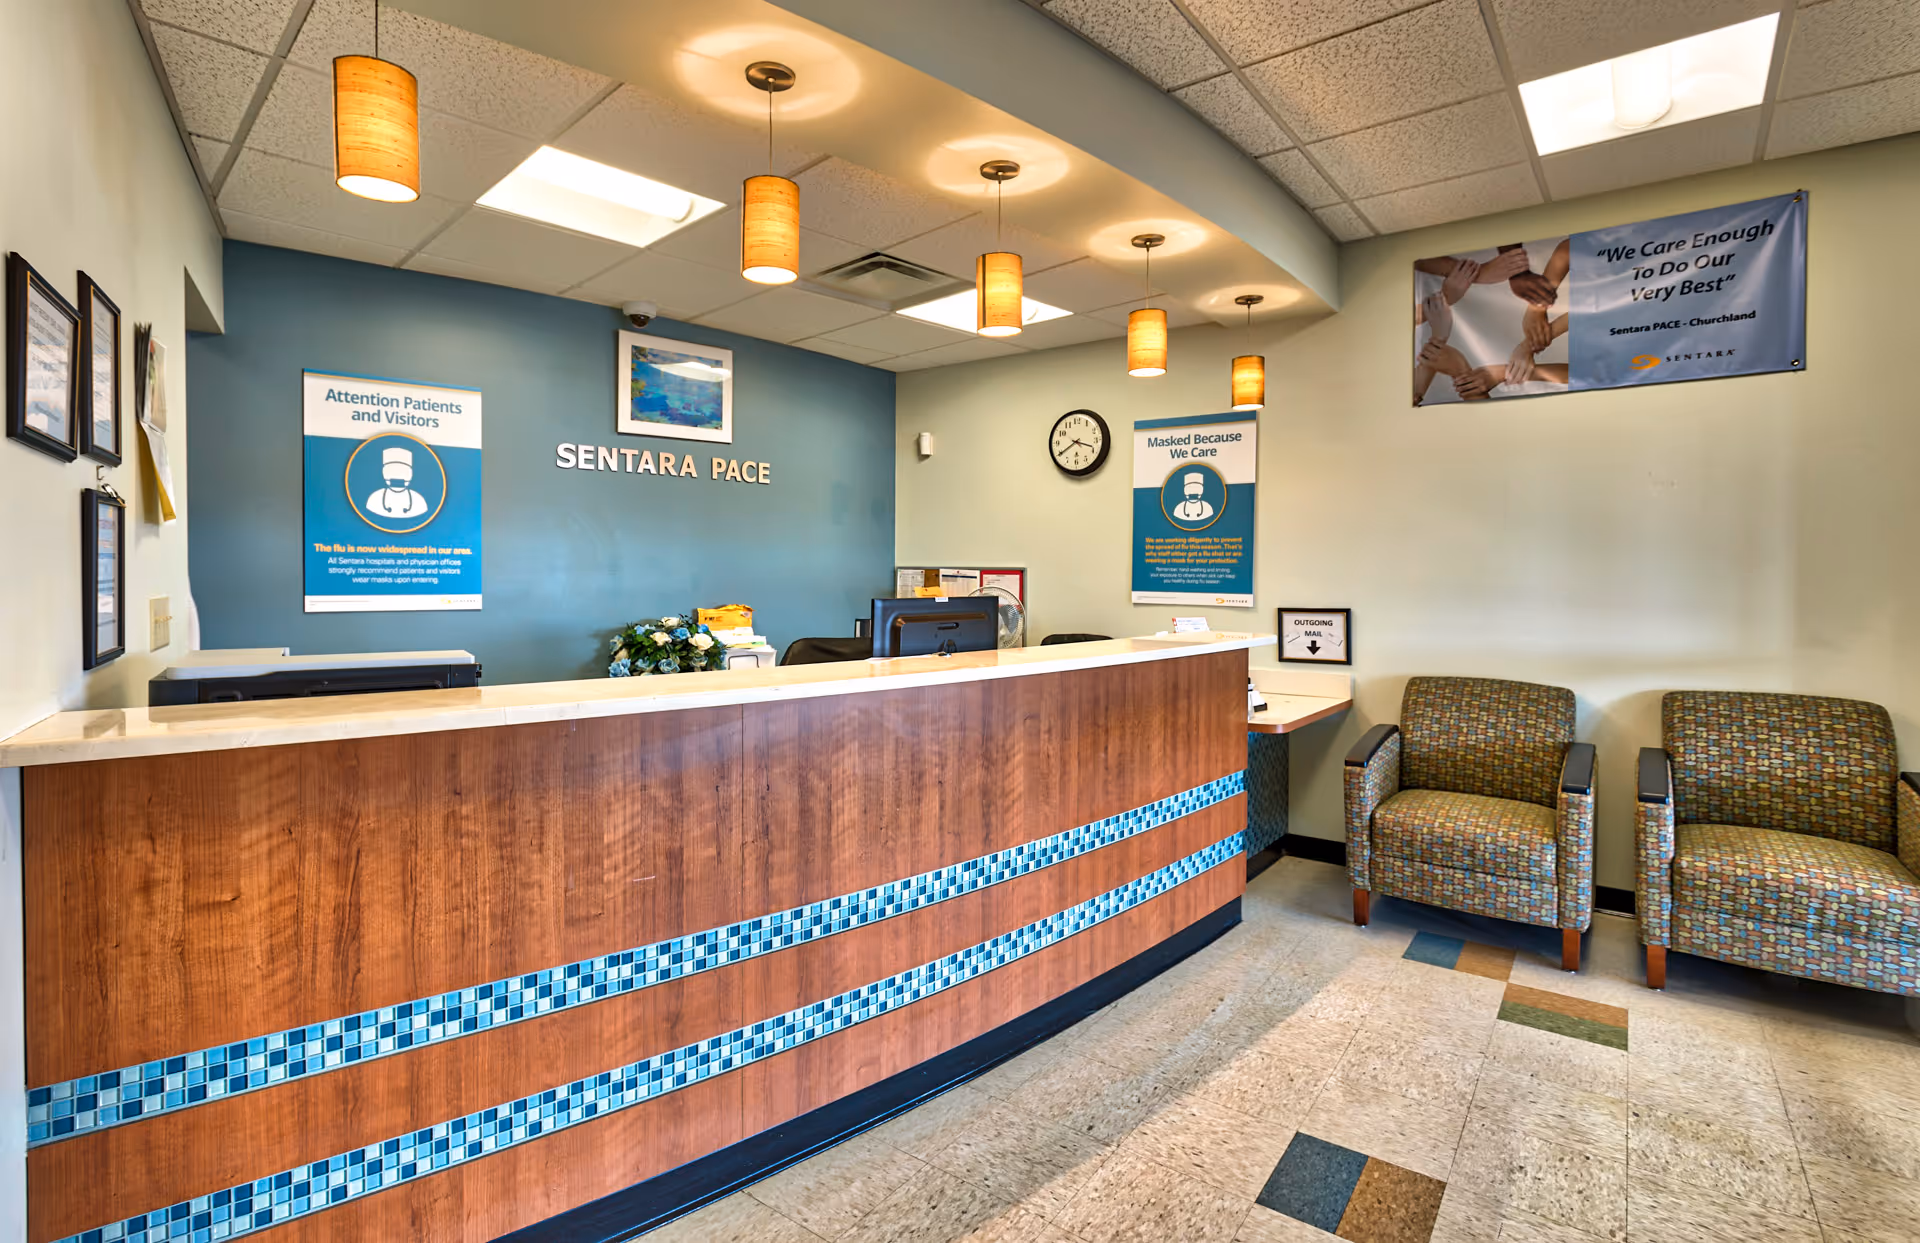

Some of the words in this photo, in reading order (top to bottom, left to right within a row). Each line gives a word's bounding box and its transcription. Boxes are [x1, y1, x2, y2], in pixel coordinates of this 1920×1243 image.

[1640, 239, 1687, 257] Care
[1692, 219, 1775, 249] Enough
[1632, 265, 1654, 281] To
[1659, 261, 1689, 276] Do
[1694, 253, 1736, 270] Our
[1631, 286, 1676, 302] Very
[1609, 325, 1651, 336] Sentara
[1653, 320, 1681, 331] PACE
[1689, 310, 1756, 327] Churchland
[325, 388, 400, 409] Attention
[403, 396, 463, 415] Patients
[351, 409, 381, 423] and
[384, 410, 440, 428] Visitors
[1147, 433, 1191, 448] Masked
[1193, 432, 1242, 445] Because
[1169, 448, 1188, 459] We
[1191, 447, 1217, 457] Care
[556, 442, 698, 478] SENTARA
[711, 457, 771, 484] PACE
[313, 543, 332, 552] The
[333, 543, 346, 553] flu
[347, 544, 355, 553] is
[378, 544, 428, 556] widespread
[428, 546, 437, 554] in
[438, 547, 452, 555] our
[327, 557, 338, 565] All
[338, 557, 365, 565] Sentara
[366, 558, 396, 567] hospitals
[410, 559, 439, 567] physician
[328, 567, 357, 576] strongly
[399, 568, 425, 576] patients
[394, 577, 411, 585] upon
